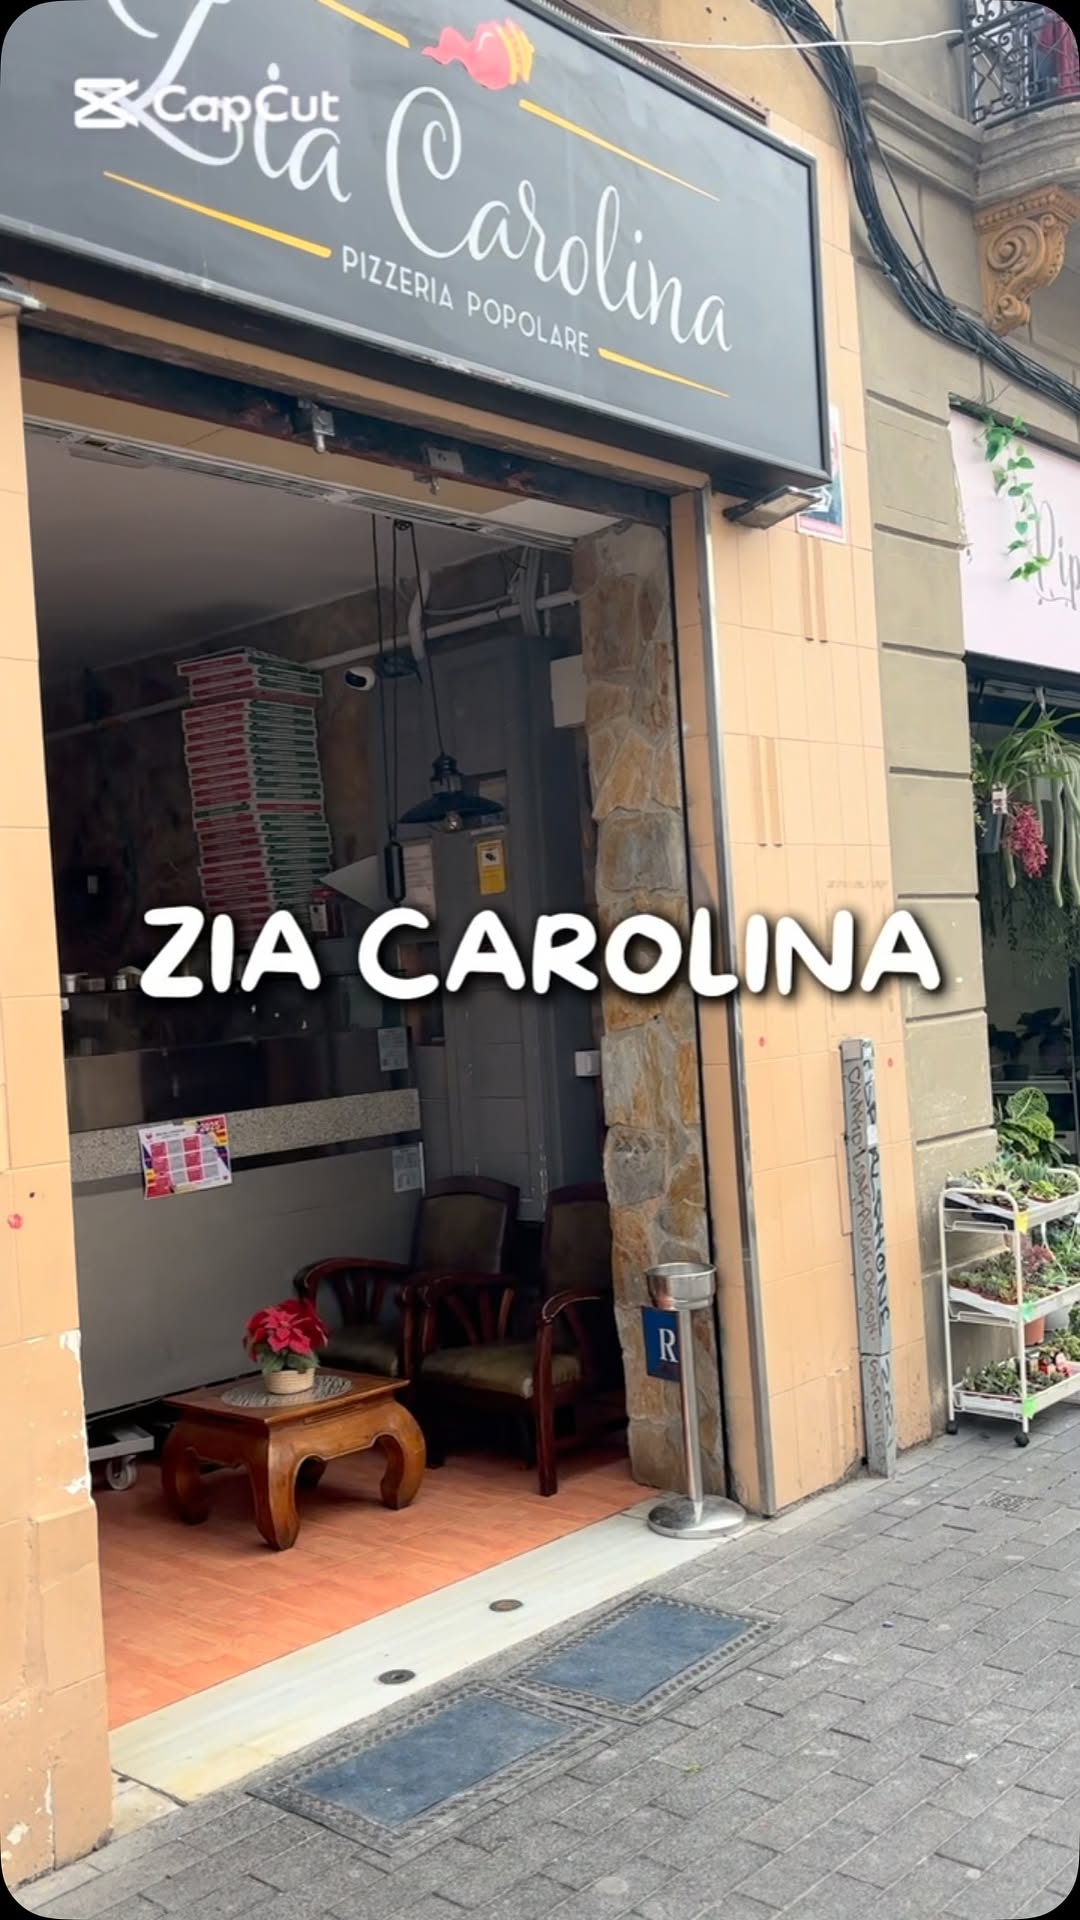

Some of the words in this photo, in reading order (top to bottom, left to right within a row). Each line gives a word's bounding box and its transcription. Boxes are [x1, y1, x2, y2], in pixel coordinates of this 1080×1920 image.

[386, 86, 732, 352] Carolina
[342, 245, 454, 310] PIZZERIA
[467, 290, 590, 358] POPOLARE
[658, 1328, 679, 1364] R
